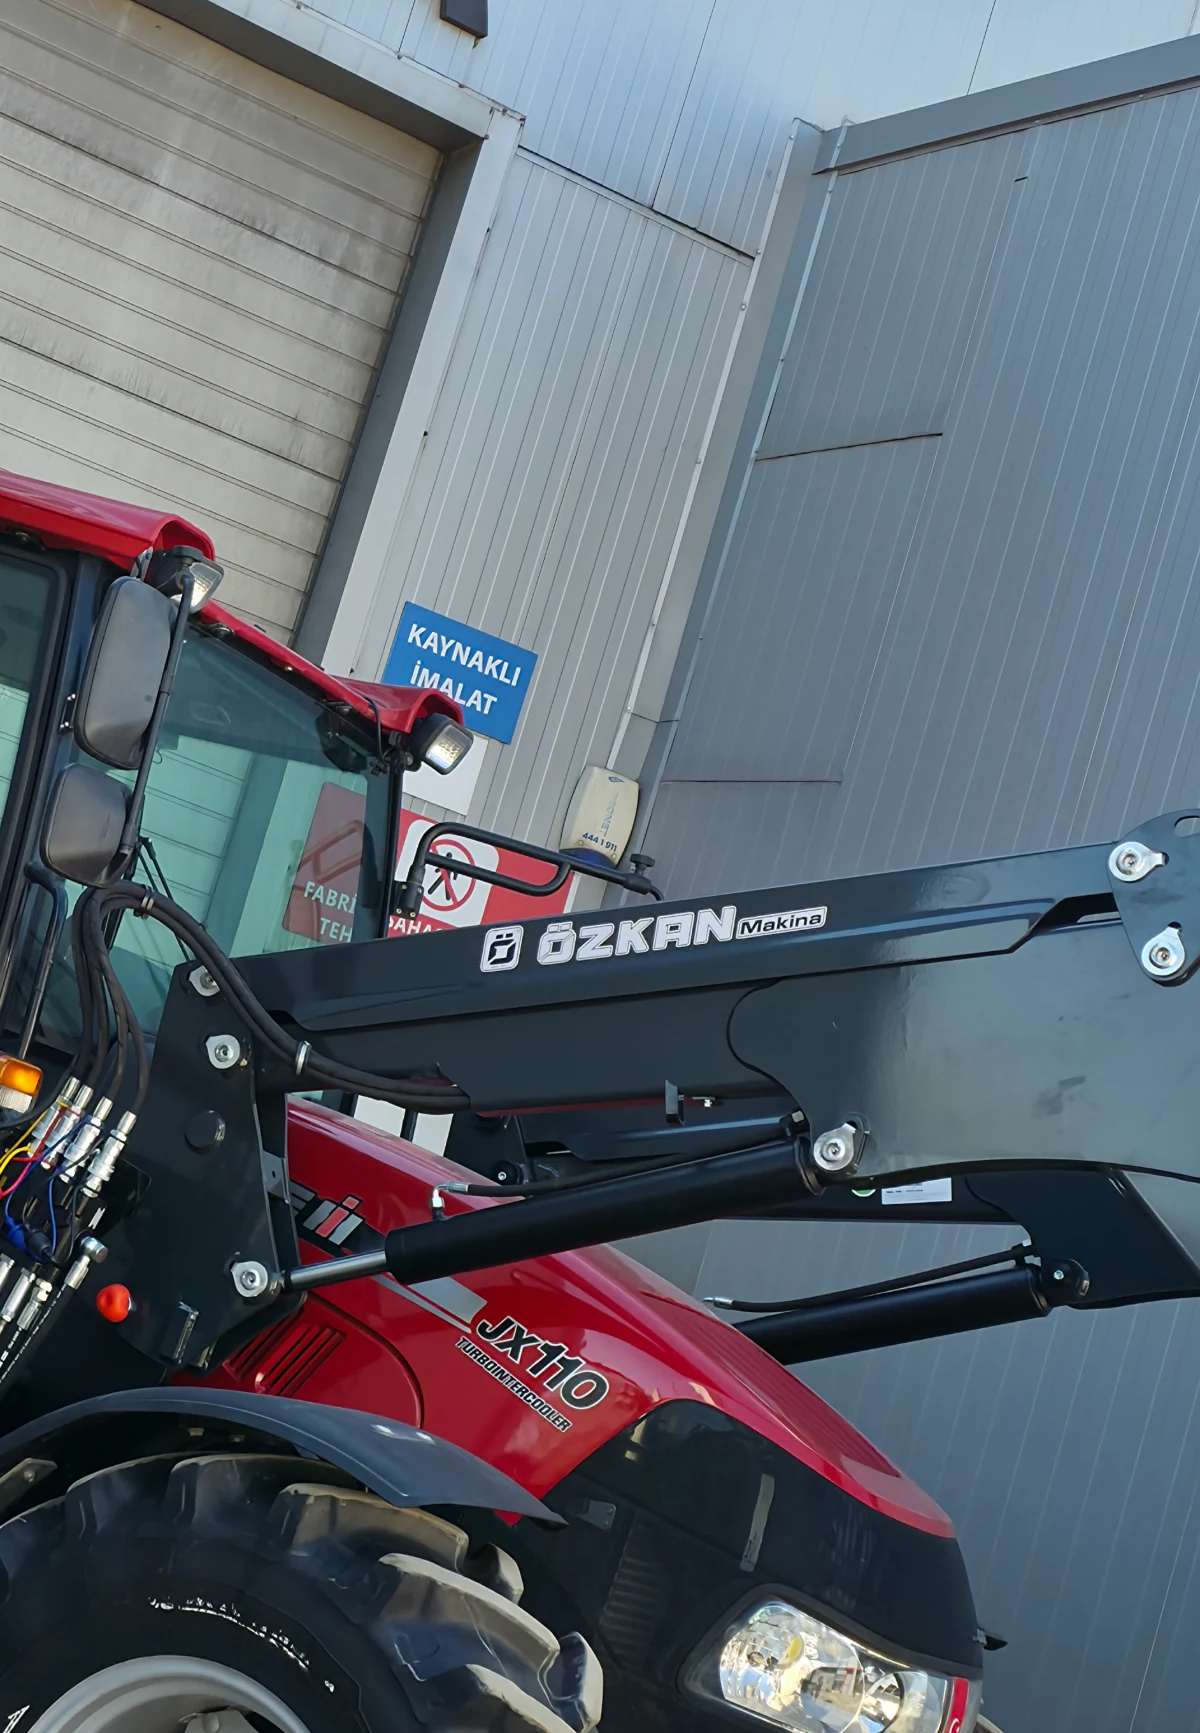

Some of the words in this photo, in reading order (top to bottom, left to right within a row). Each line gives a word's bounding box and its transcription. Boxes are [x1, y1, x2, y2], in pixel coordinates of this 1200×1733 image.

[407, 623, 522, 687] KAYNAKLI
[410, 660, 498, 715] İMALAT
[582, 832, 598, 843] 444
[605, 841, 618, 852] 911
[303, 881, 357, 914] FABRİ
[536, 906, 737, 965] ÖZKAN
[741, 911, 822, 937] Makina
[455, 1336, 573, 1432] TURBOINTERCOOLER
[476, 1315, 609, 1410] JX110
